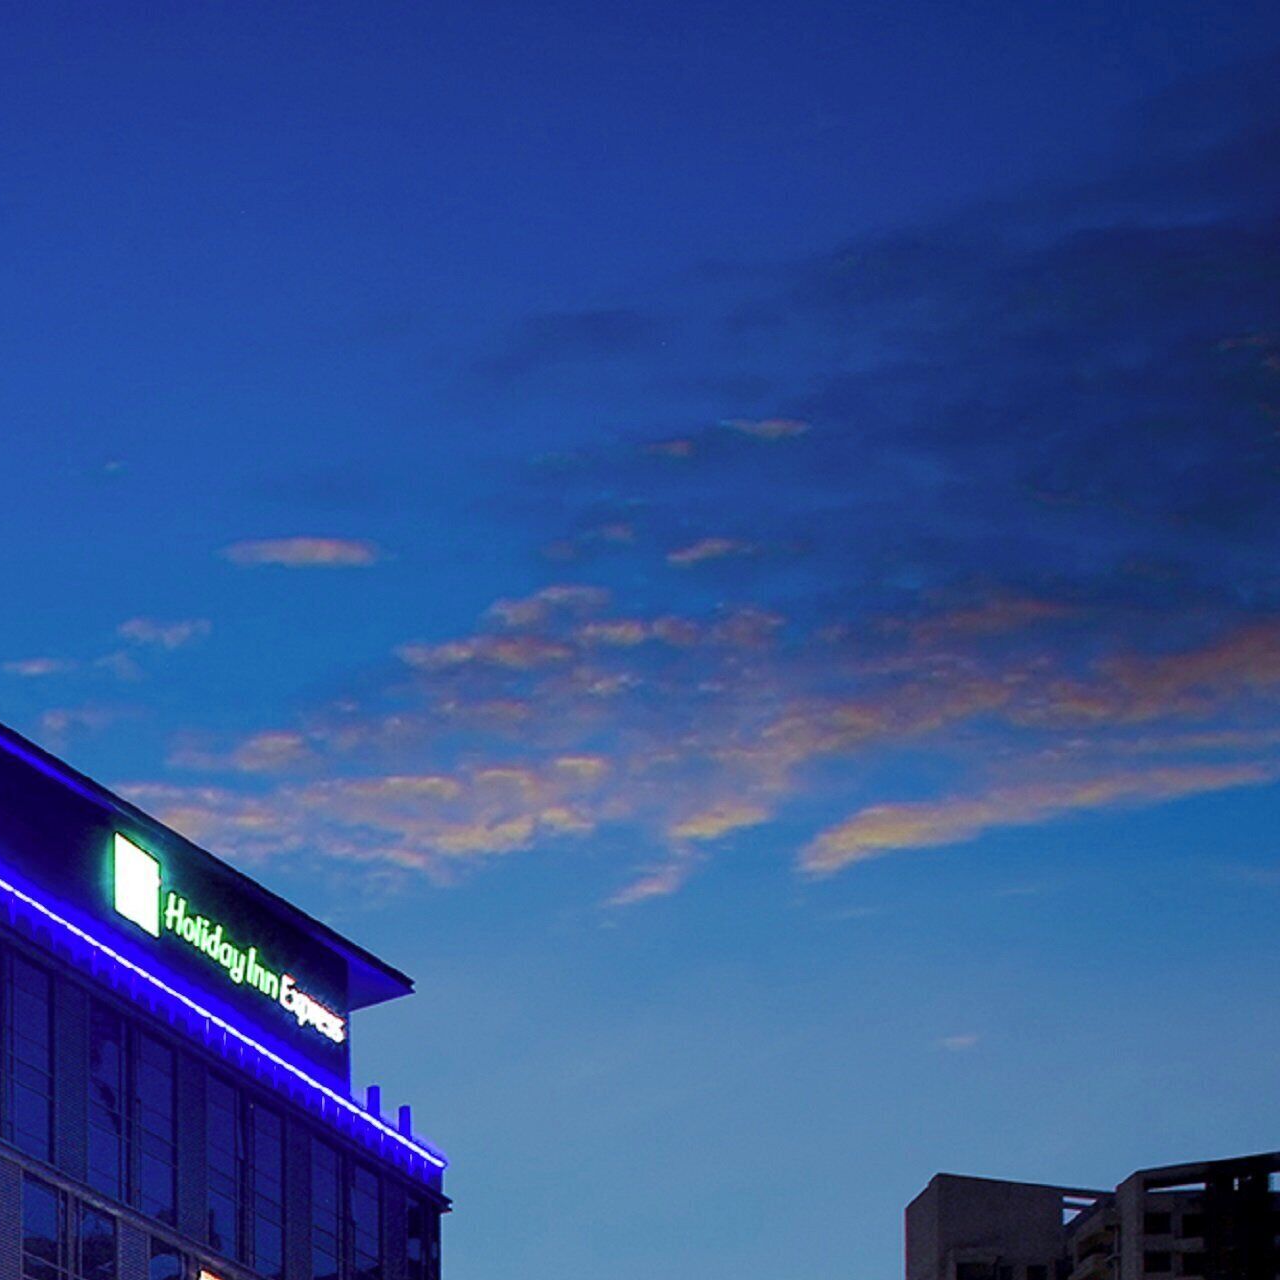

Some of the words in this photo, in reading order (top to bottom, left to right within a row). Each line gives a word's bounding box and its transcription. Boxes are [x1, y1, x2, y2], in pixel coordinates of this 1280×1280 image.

[164, 891, 246, 984] Holiday
[246, 947, 279, 1000] Inn
[279, 973, 345, 1043] Express
